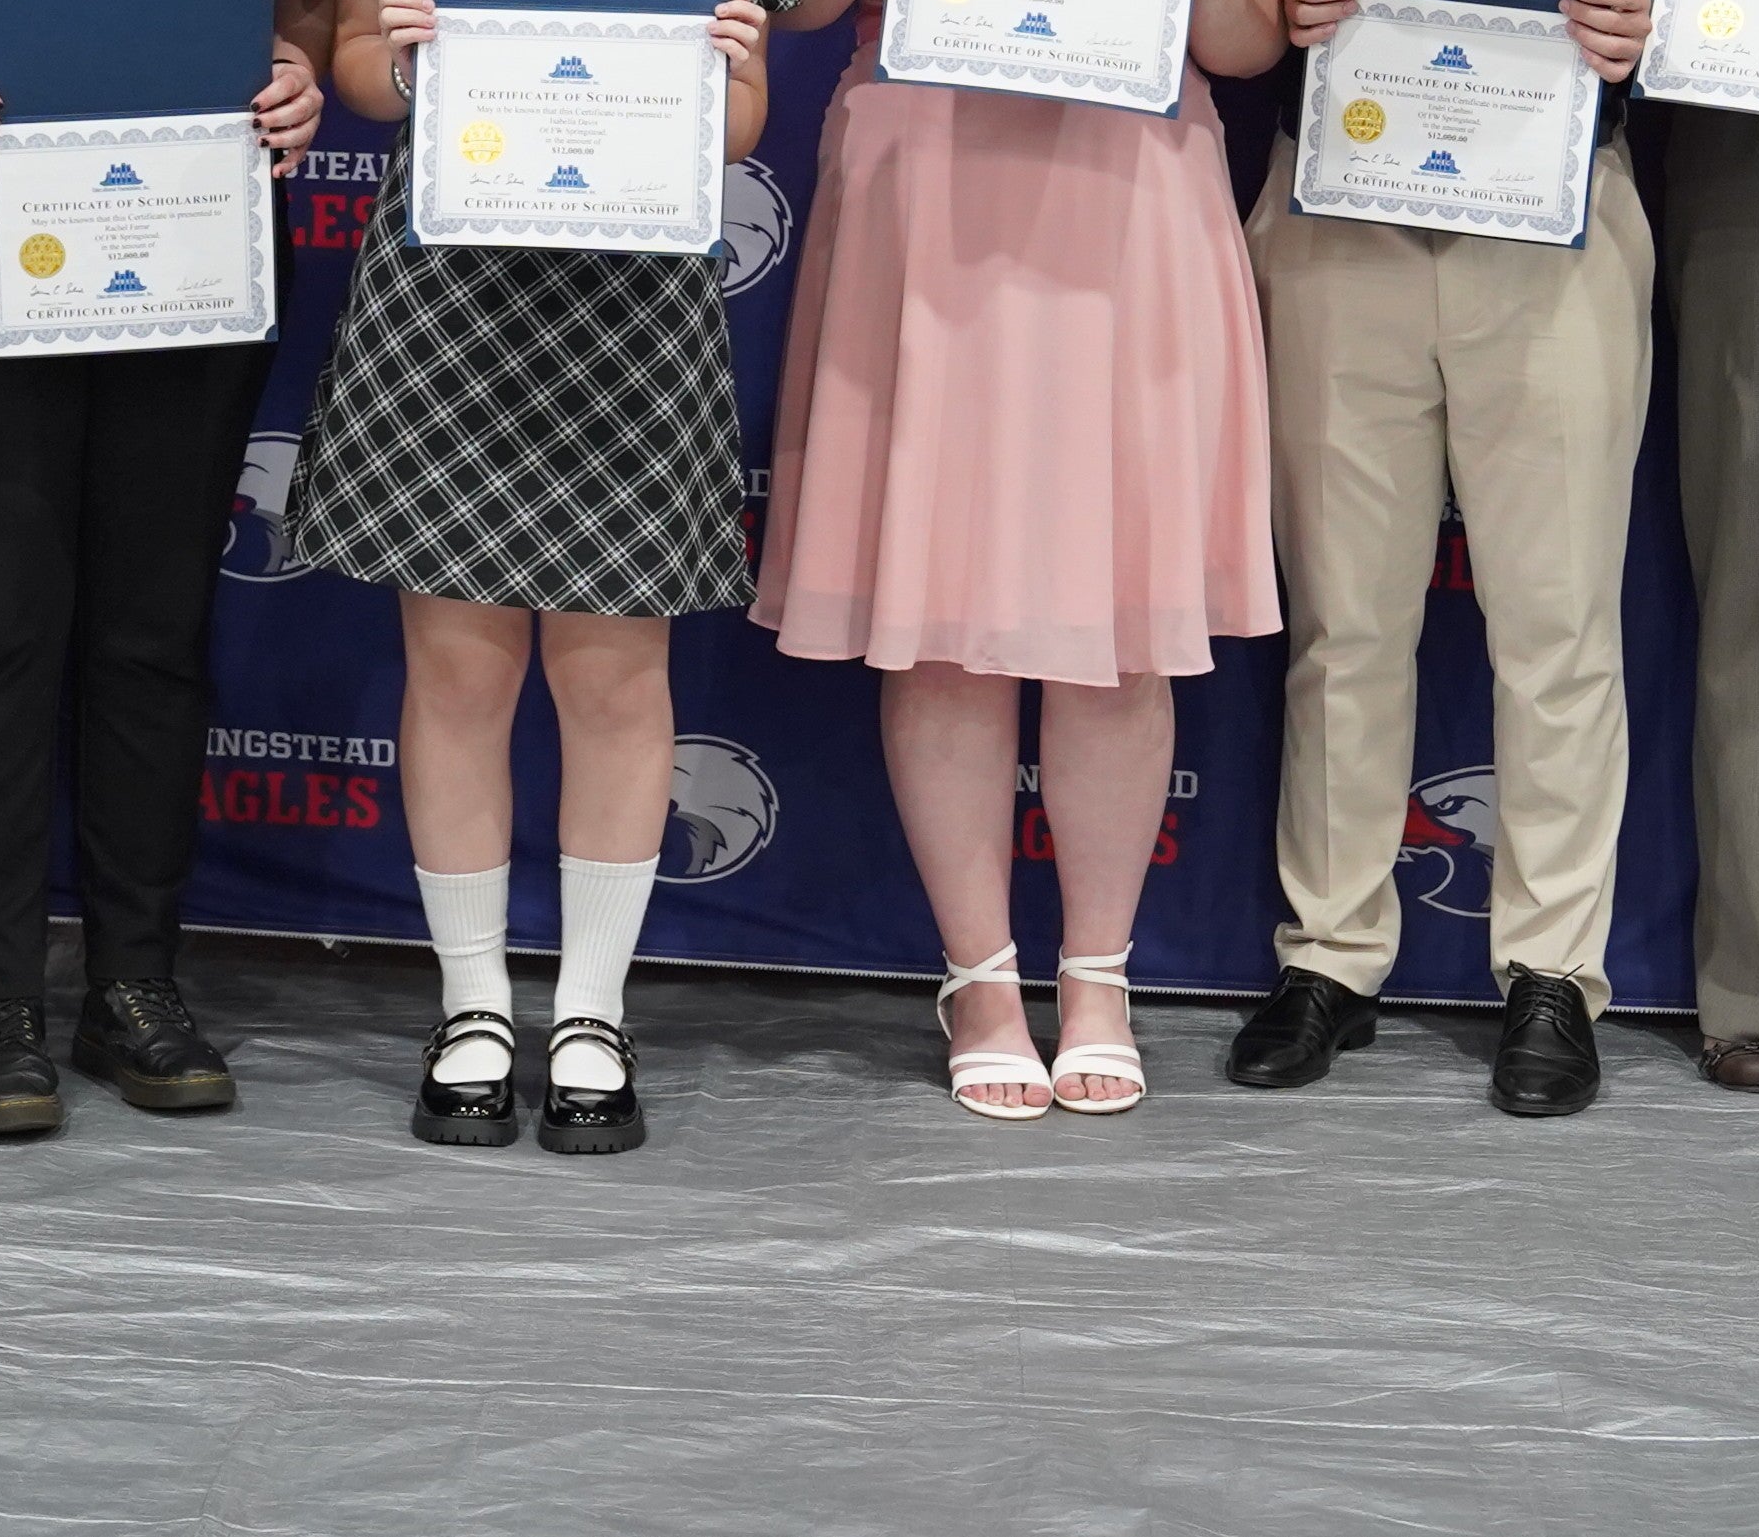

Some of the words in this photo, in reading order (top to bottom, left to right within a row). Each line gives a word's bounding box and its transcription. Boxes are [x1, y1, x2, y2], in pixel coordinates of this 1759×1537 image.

[932, 34, 1022, 56] CERTIFICATE
[1026, 48, 1044, 58] OF
[1047, 49, 1142, 72] SCHOLARSHIP
[467, 87, 559, 101] CERTIFICATE
[563, 92, 581, 102] OF
[585, 91, 683, 106] SCHOLARSHIP
[1353, 68, 1439, 88] CERTIFICATE
[1443, 80, 1460, 91] OF
[1463, 81, 1556, 102] SCHOLARSHIP
[1360, 84, 1378, 96] May
[1395, 88, 1421, 100] known
[1421, 92, 1436, 102] that
[1436, 94, 1451, 103] this
[1451, 95, 1491, 108] Certificate
[1499, 103, 1536, 113] presented
[21, 199, 112, 214] CERTIFICATE
[116, 198, 133, 208] OF
[137, 193, 231, 207] SCHOLARSHIP
[1342, 172, 1428, 193] CERTIFICATE
[1431, 185, 1449, 195] OF
[1451, 186, 1544, 208] SCHOLARSHIP
[30, 217, 49, 228] May
[68, 216, 95, 224] known
[95, 214, 111, 223] that
[111, 213, 127, 222] this
[126, 211, 167, 221] Certificate
[176, 208, 213, 221] presented
[463, 196, 556, 211] CERTIFICATE
[560, 201, 579, 212] OF
[582, 201, 679, 216] SCHOLARSHIP
[25, 306, 116, 321] CERTIFICATE
[120, 304, 137, 314] OF
[141, 298, 235, 313] SCHOLARSHIP
[206, 728, 396, 767] INGSTEAD
[200, 770, 381, 828] AGLES
